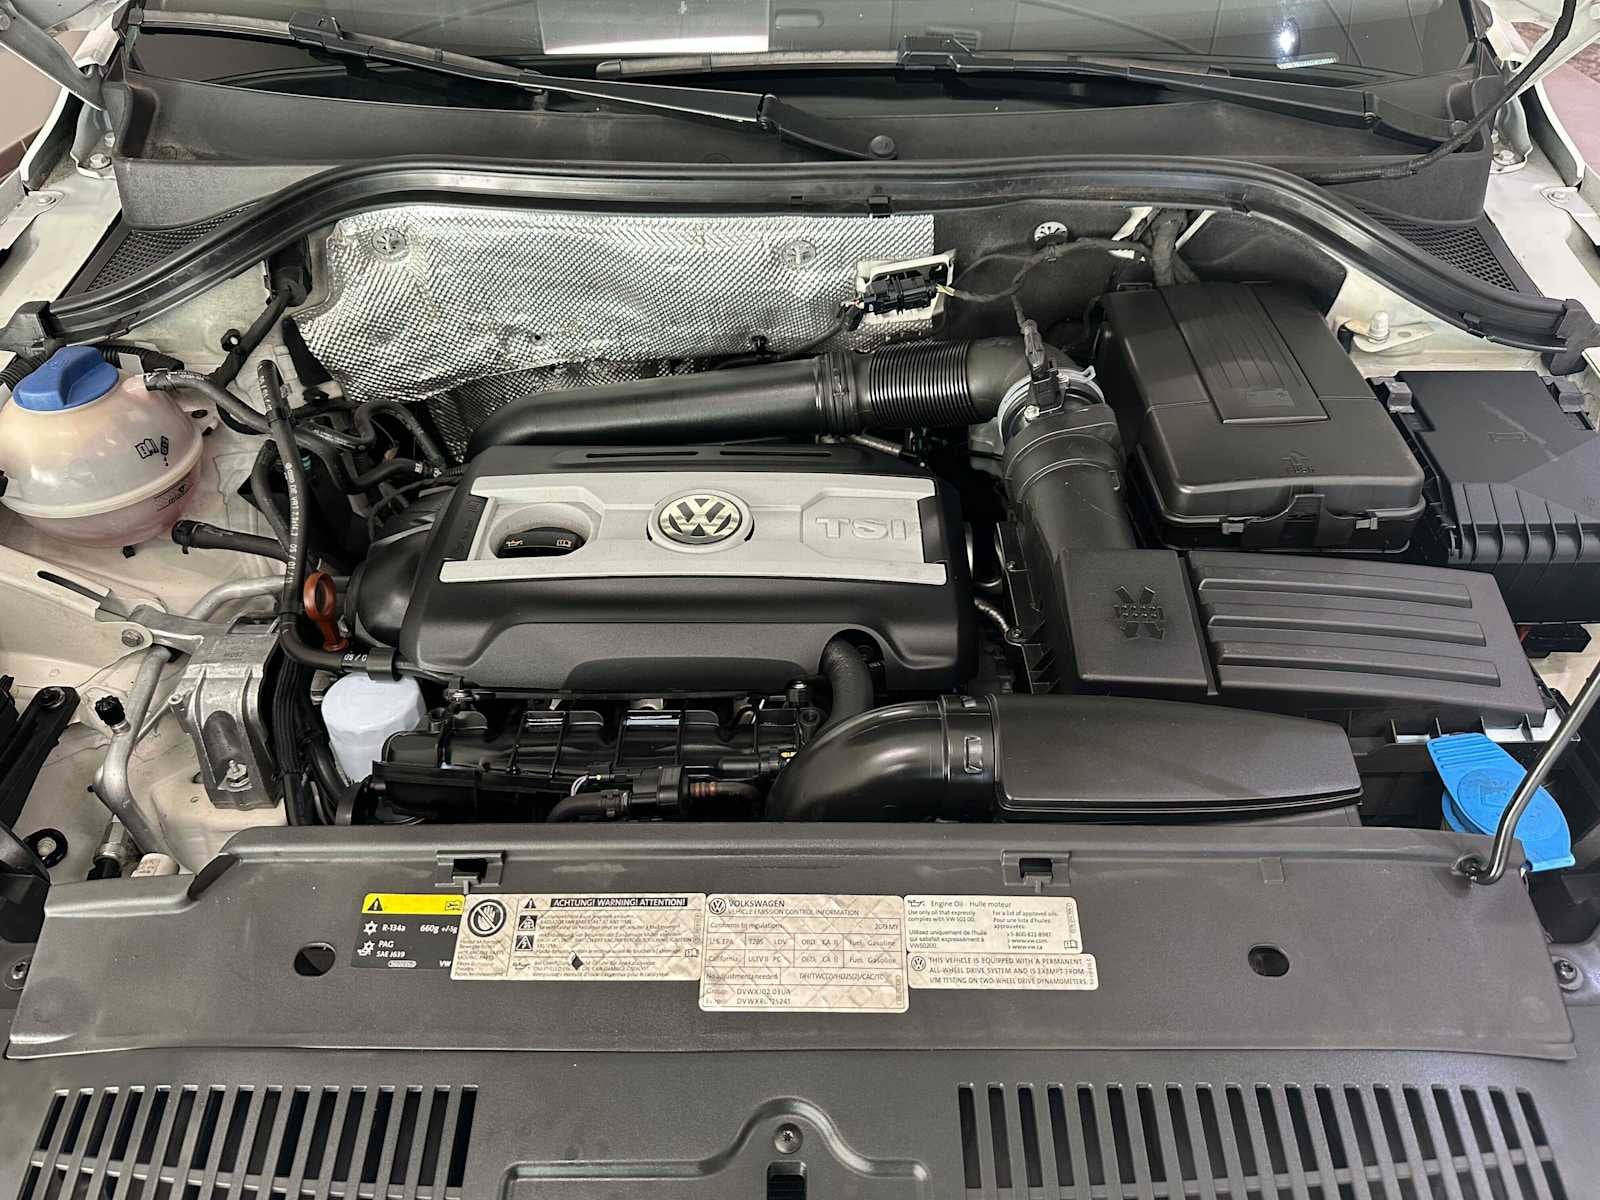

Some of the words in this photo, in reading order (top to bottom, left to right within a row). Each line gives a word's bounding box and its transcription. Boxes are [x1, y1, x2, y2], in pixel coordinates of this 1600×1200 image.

[815, 517, 907, 539] TSI
[554, 898, 596, 907] ACHTUNG!
[597, 898, 639, 907] WARNING!
[640, 898, 686, 907] ATTENTION!
[381, 923, 406, 932] R-134a
[420, 924, 439, 934] 660g
[378, 940, 394, 948] PAG
[376, 950, 389, 958] SAE
